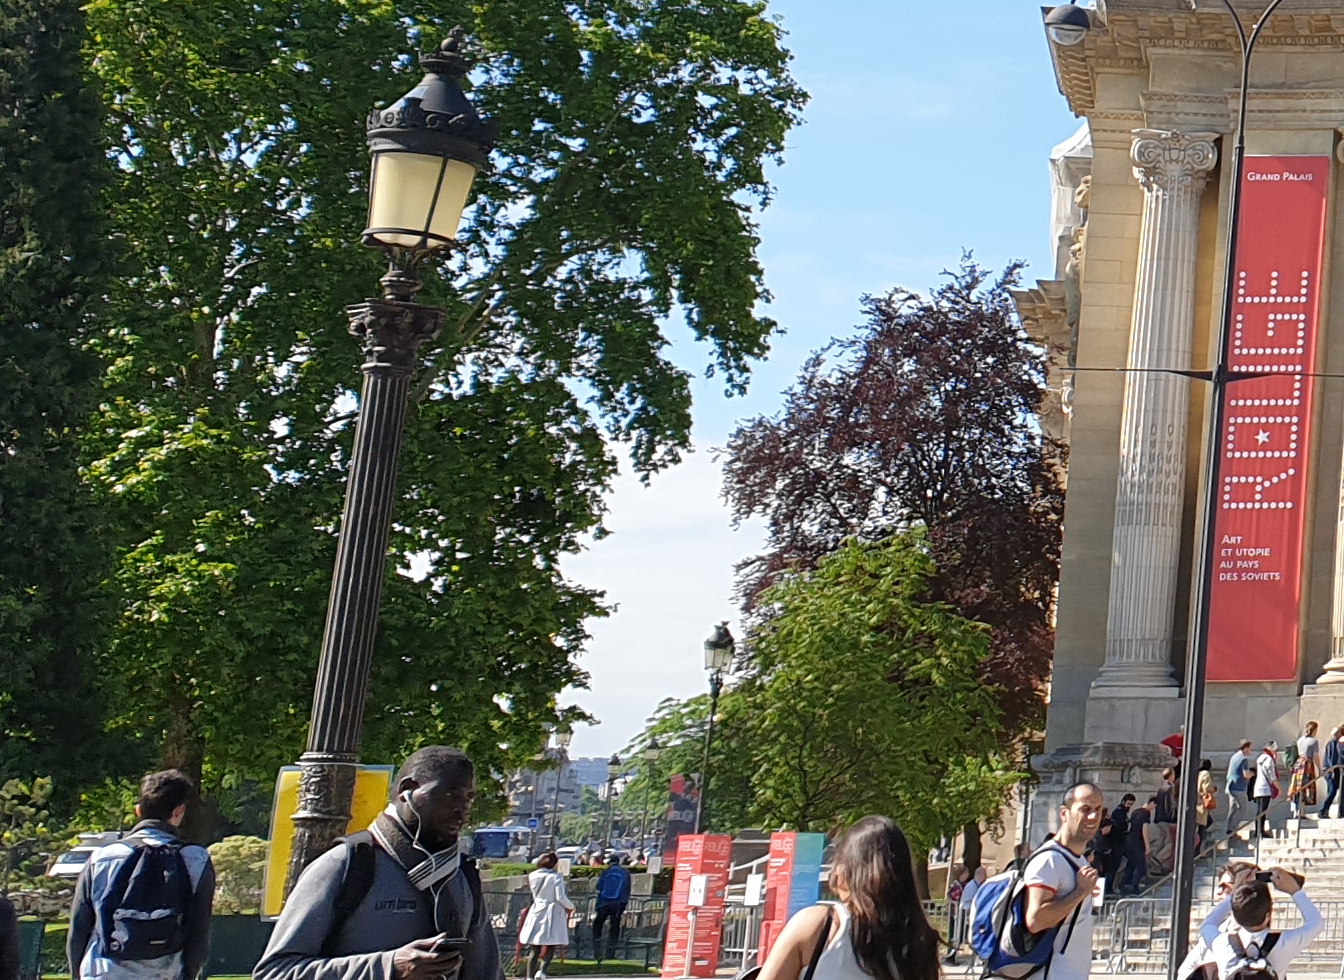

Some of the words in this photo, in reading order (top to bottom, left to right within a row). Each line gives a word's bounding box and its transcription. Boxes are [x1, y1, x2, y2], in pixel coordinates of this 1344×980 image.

[1223, 271, 1308, 509] ROUGE
[1236, 548, 1271, 556] UTOPIE
[1220, 573, 1238, 581] DES
[1241, 572, 1281, 581] SOVIETS
